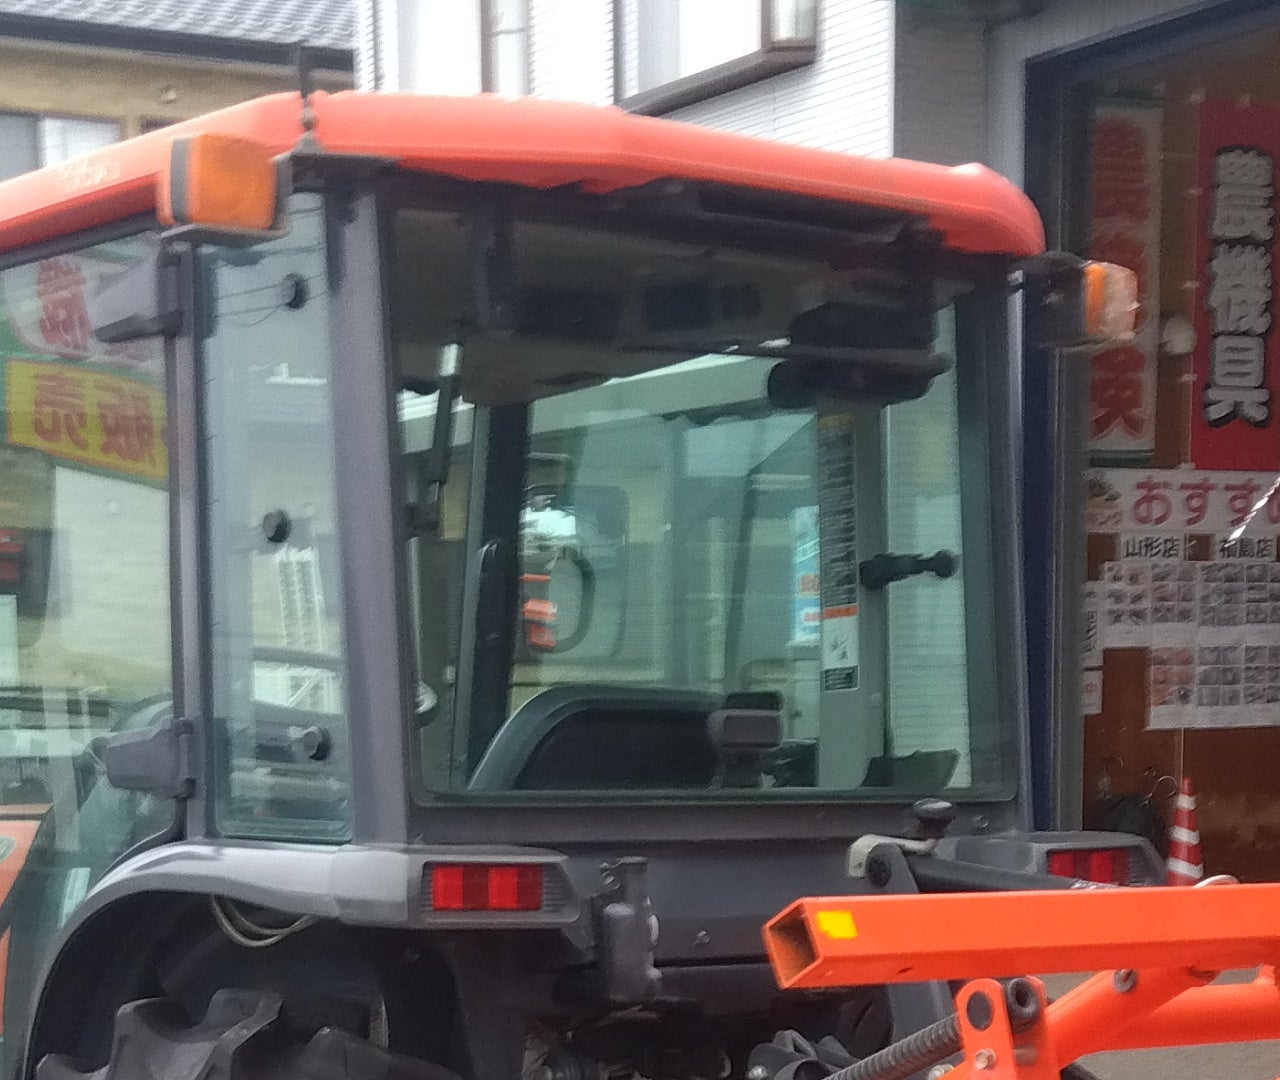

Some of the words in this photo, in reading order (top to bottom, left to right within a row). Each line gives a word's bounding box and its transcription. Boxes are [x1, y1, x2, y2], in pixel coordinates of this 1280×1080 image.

[1205, 148, 1273, 426] 農機具
[1122, 537, 1180, 559] 山形店
